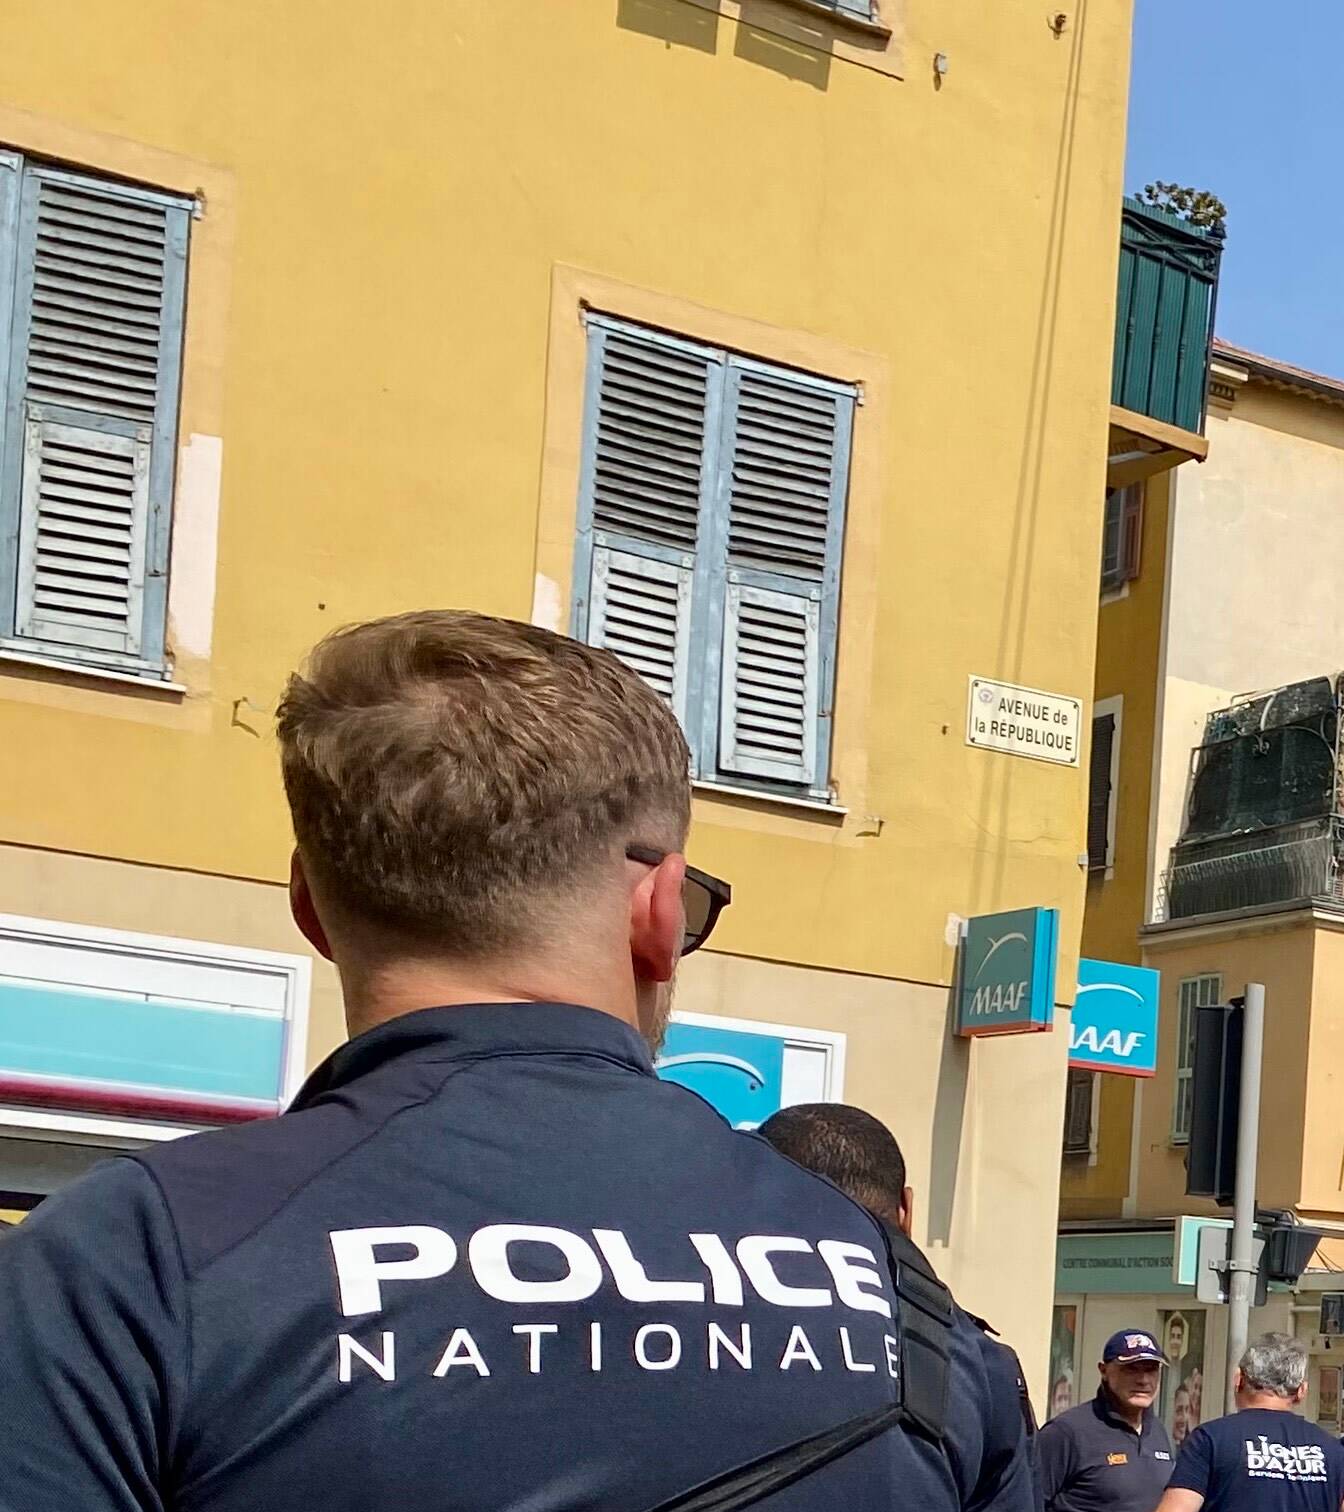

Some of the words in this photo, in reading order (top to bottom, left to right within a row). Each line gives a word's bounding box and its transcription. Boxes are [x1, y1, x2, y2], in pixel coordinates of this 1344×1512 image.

[998, 697, 1049, 721] AVENUE
[1053, 709, 1068, 725] de
[975, 716, 986, 733] la
[990, 718, 1073, 751] RÉPUBLIQUE
[970, 981, 1028, 1015] MAAF
[329, 1223, 892, 1318] POLICE
[337, 1322, 898, 1383] NATIONALE
[1246, 1435, 1325, 1461] LIGNES
[1247, 1454, 1327, 1475] D'AZUR
